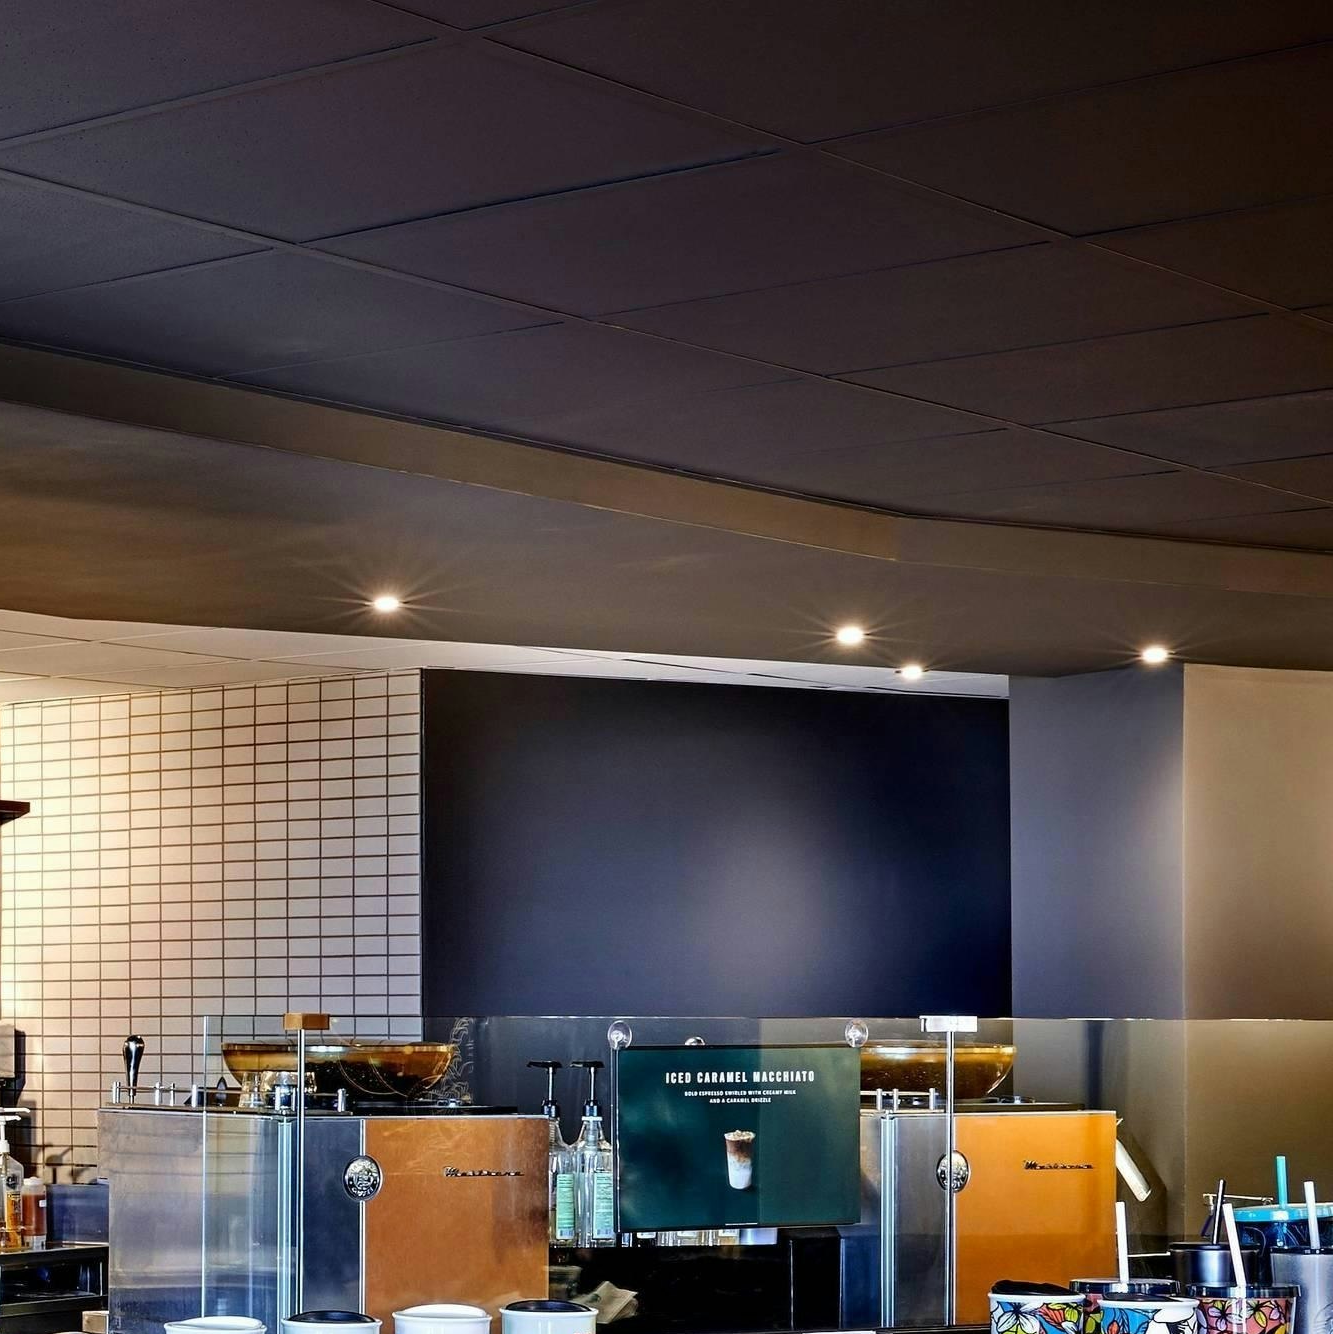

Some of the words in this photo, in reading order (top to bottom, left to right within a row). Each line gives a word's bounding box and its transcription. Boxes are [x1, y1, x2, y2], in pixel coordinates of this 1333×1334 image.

[666, 1073, 691, 1083] ICED
[697, 1072, 747, 1083] CARAMEL
[753, 1071, 814, 1082] MACCHIATO
